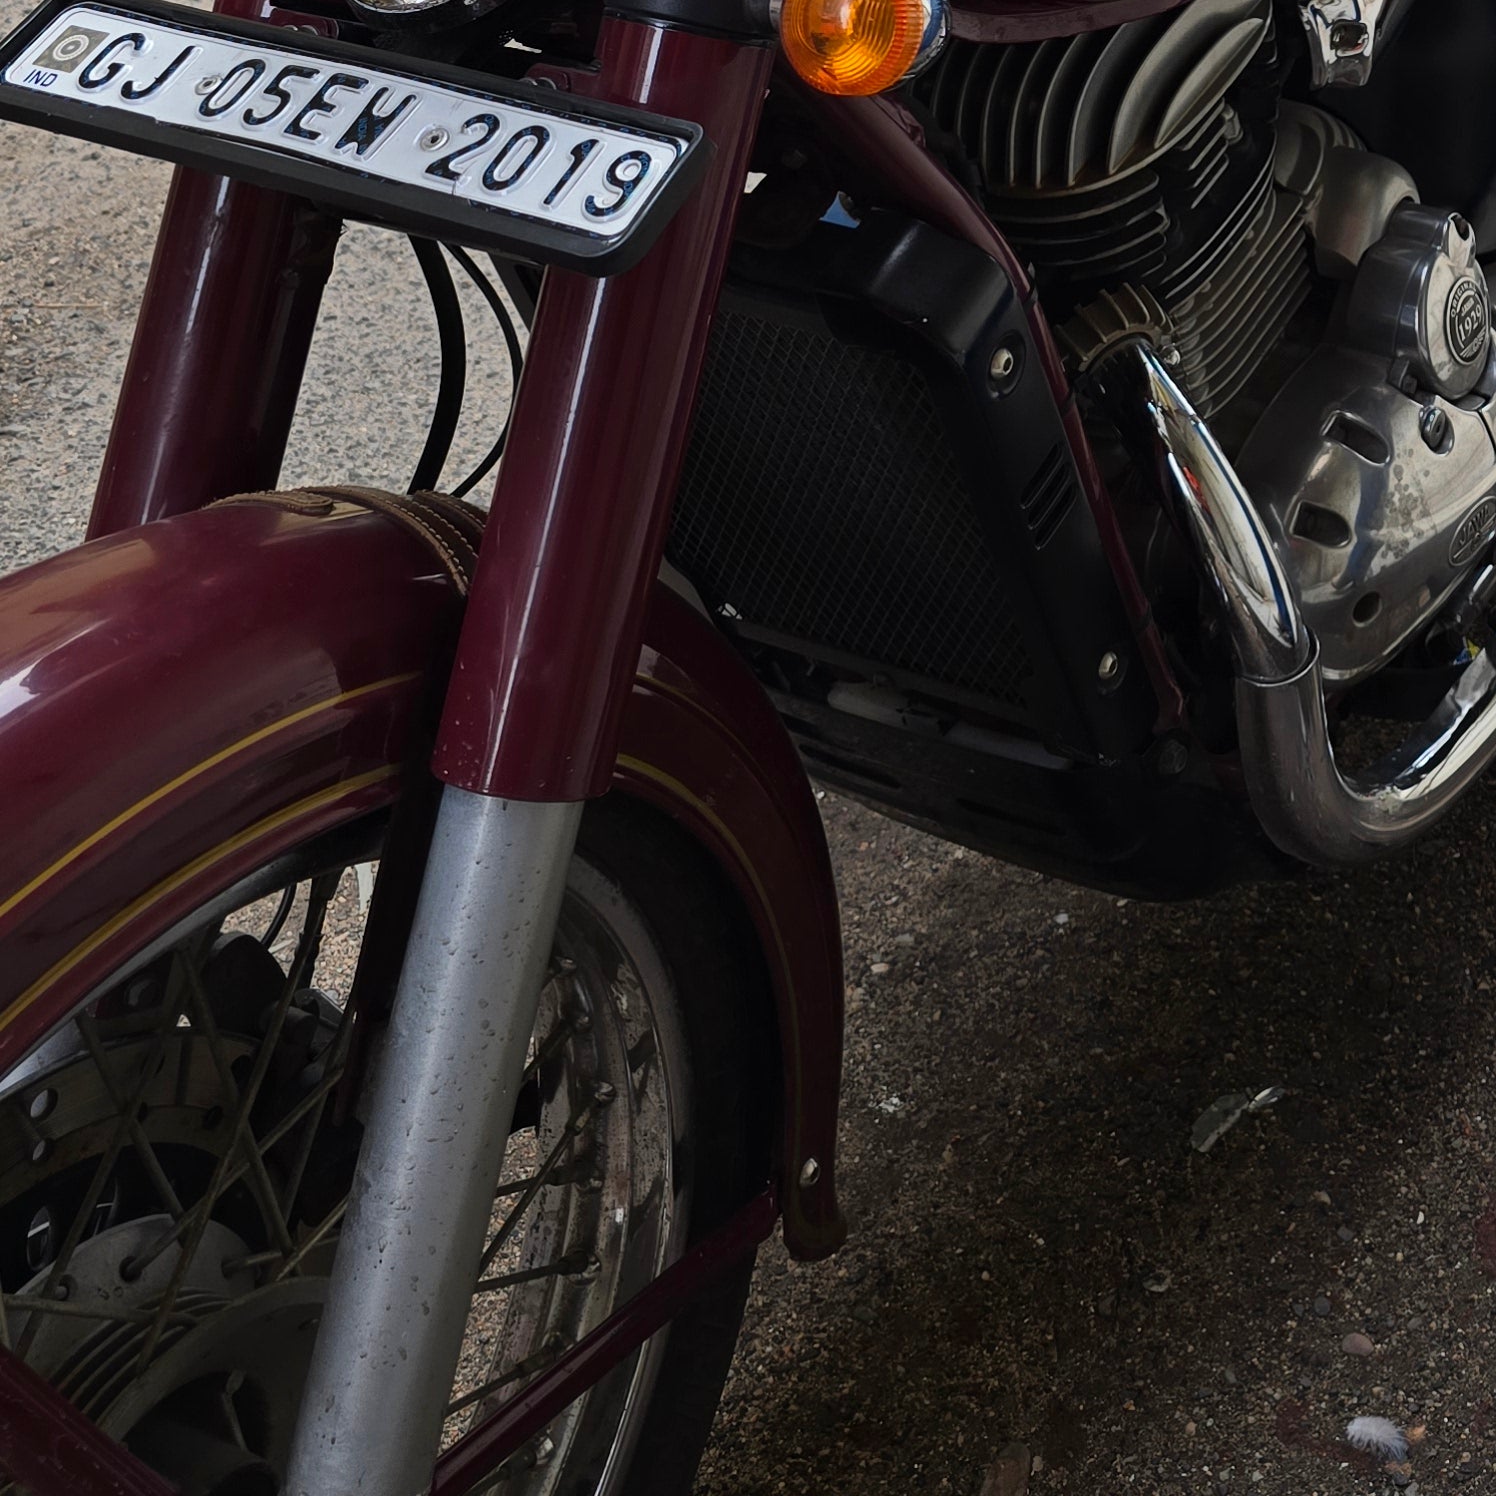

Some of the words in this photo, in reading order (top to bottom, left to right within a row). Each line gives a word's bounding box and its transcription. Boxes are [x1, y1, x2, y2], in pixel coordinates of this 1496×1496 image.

[23, 69, 58, 87] IND
[78, 32, 196, 100] GJ
[424, 113, 652, 218] 2019
[1451, 281, 1476, 318] ORIGINAL
[1459, 304, 1482, 342] 1929
[1460, 503, 1490, 546] JAWA
